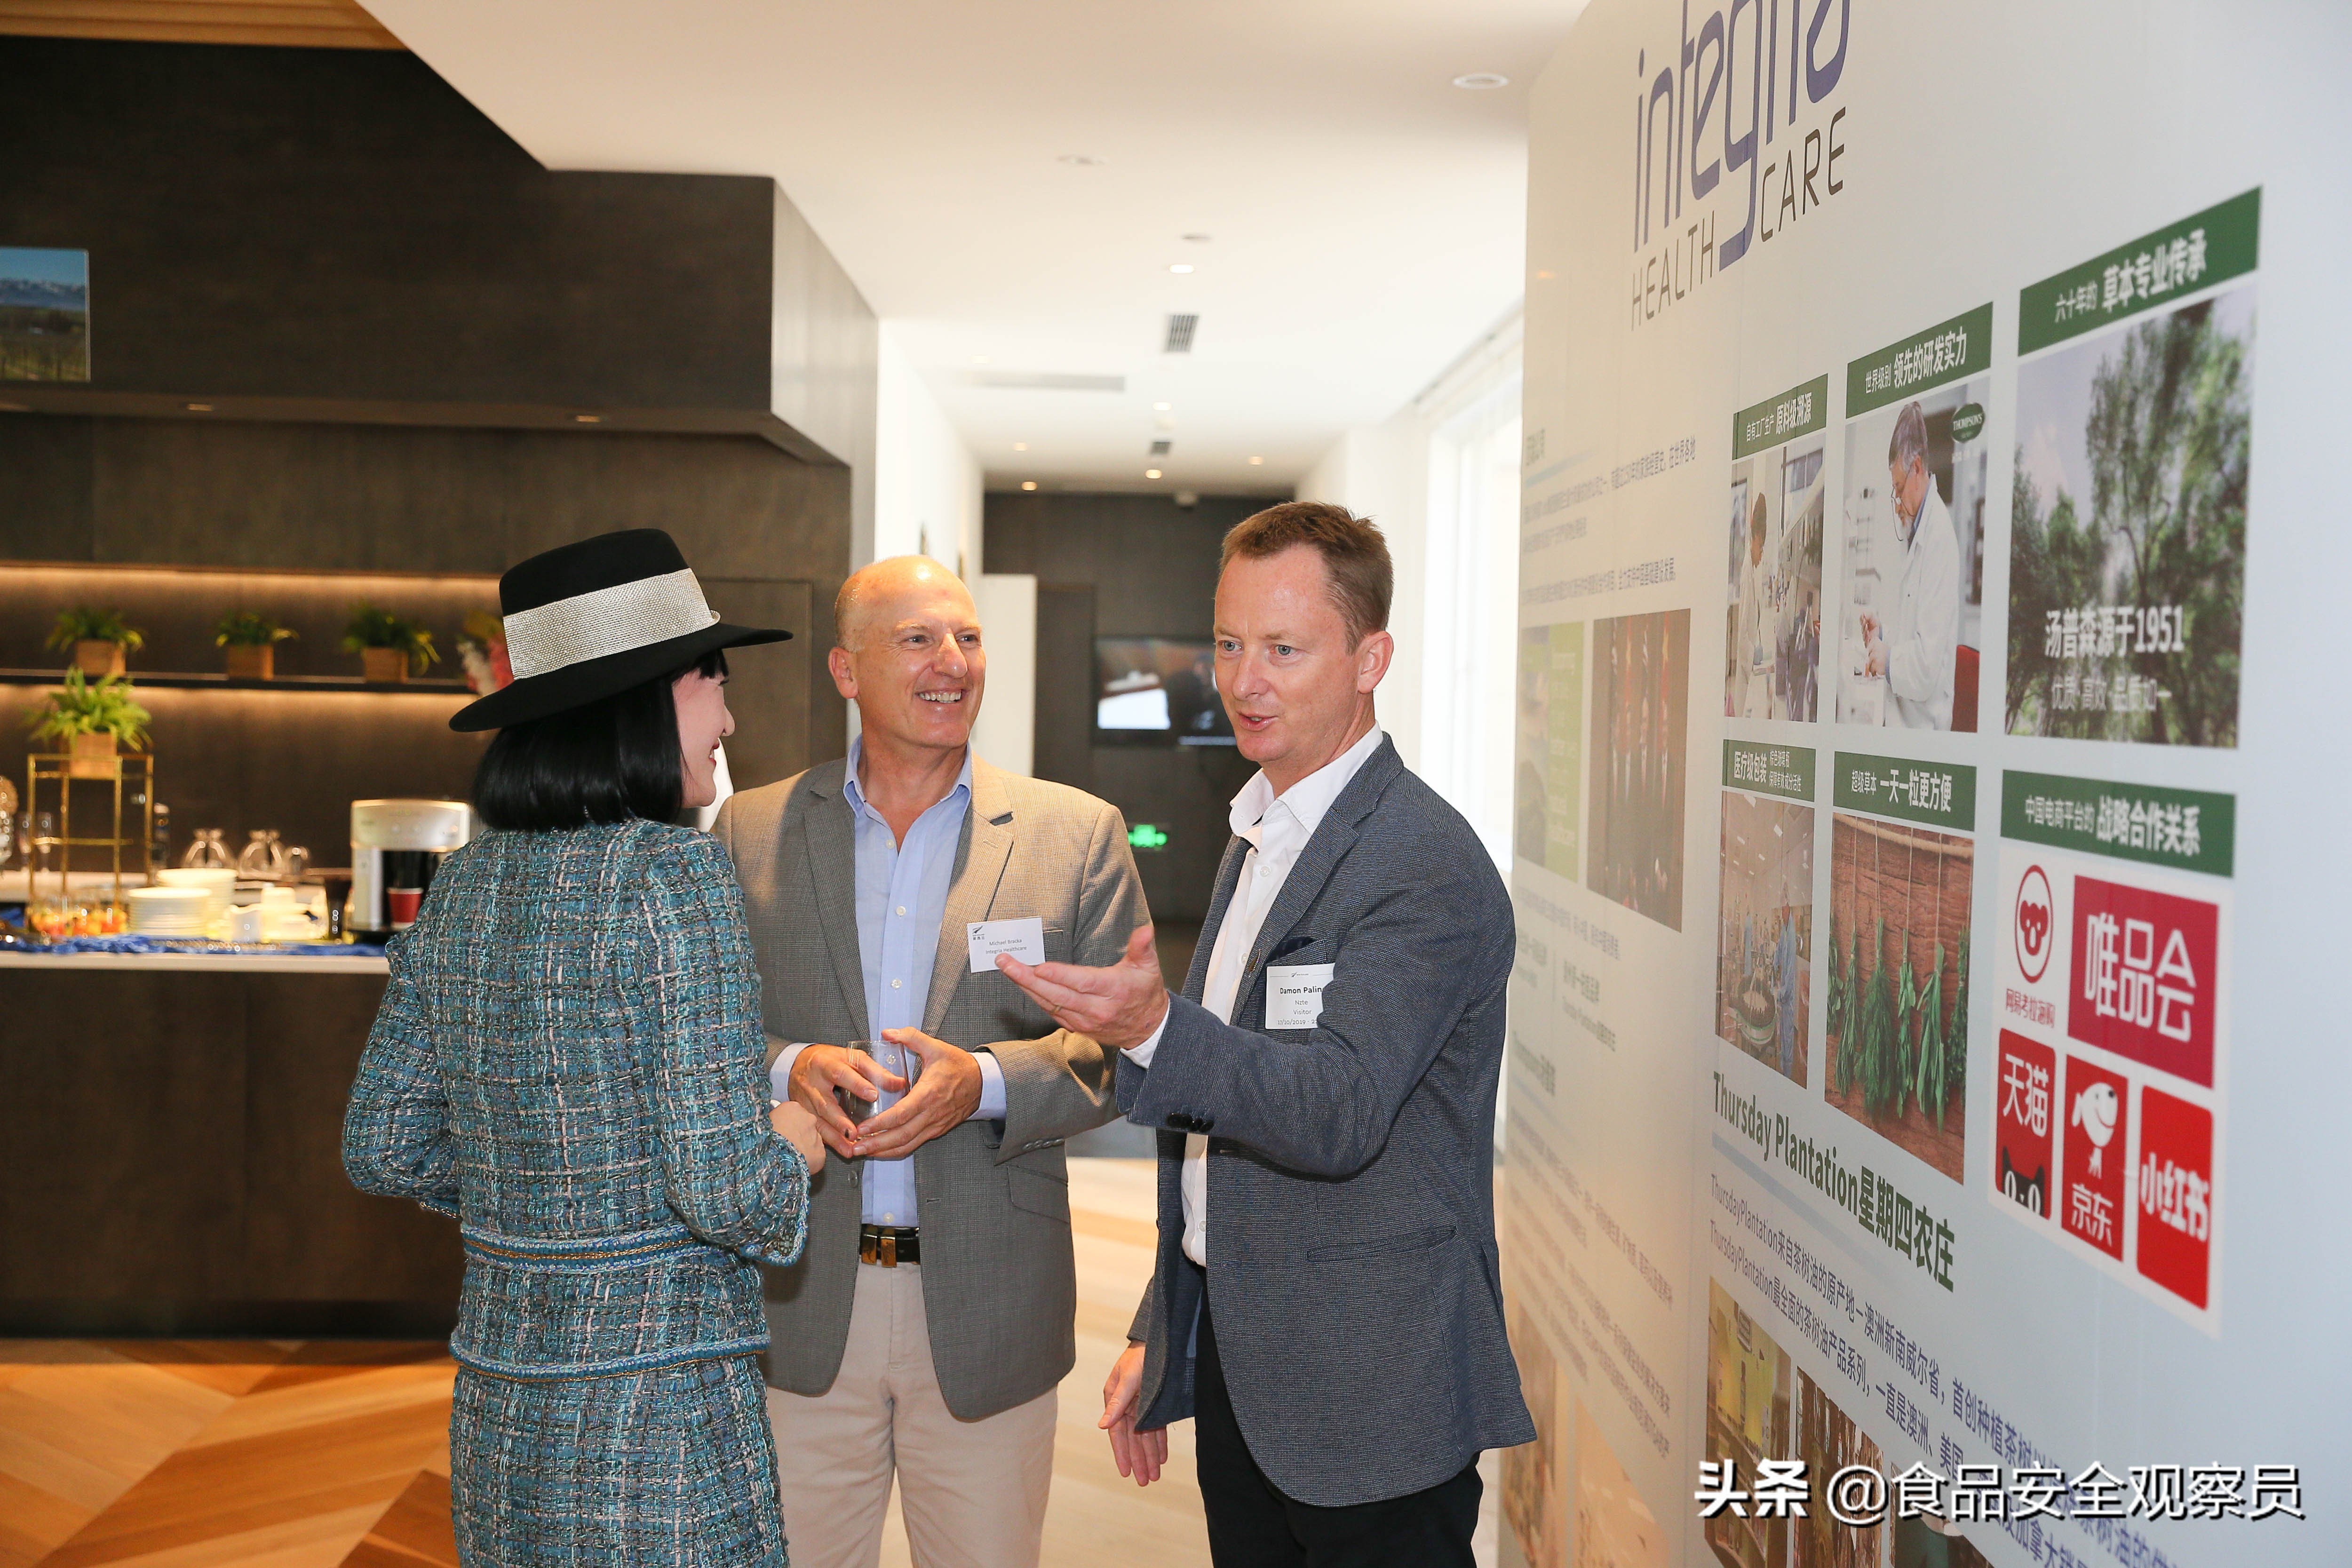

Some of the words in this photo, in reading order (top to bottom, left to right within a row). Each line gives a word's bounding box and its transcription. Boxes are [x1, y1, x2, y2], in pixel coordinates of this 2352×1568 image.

[1631, 210, 1715, 331] HEALTH
[1761, 106, 1846, 242] CARE
[2101, 227, 2207, 313] 草本专业传承
[1894, 326, 1967, 389] 领先的研发实力
[1775, 391, 1812, 435] 原料级溯源
[2044, 605, 2184, 659] 汤普森源于1951
[1734, 751, 1767, 783] 医疗级包装
[1851, 772, 1877, 796] 超级草本
[1880, 769, 1952, 813] 一天一粒更方便
[2025, 795, 2095, 834] 中国电商平台的
[2096, 795, 2201, 857] 战略合作关系
[2084, 912, 2197, 1043] 唯品会
[2003, 1053, 2049, 1138] 天猫
[1714, 1071, 1772, 1162] Thursday
[1776, 1113, 1955, 1293] Plantation星期四农庄
[2140, 1152, 2209, 1242] 小红书
[2071, 1183, 2114, 1247] 京东
